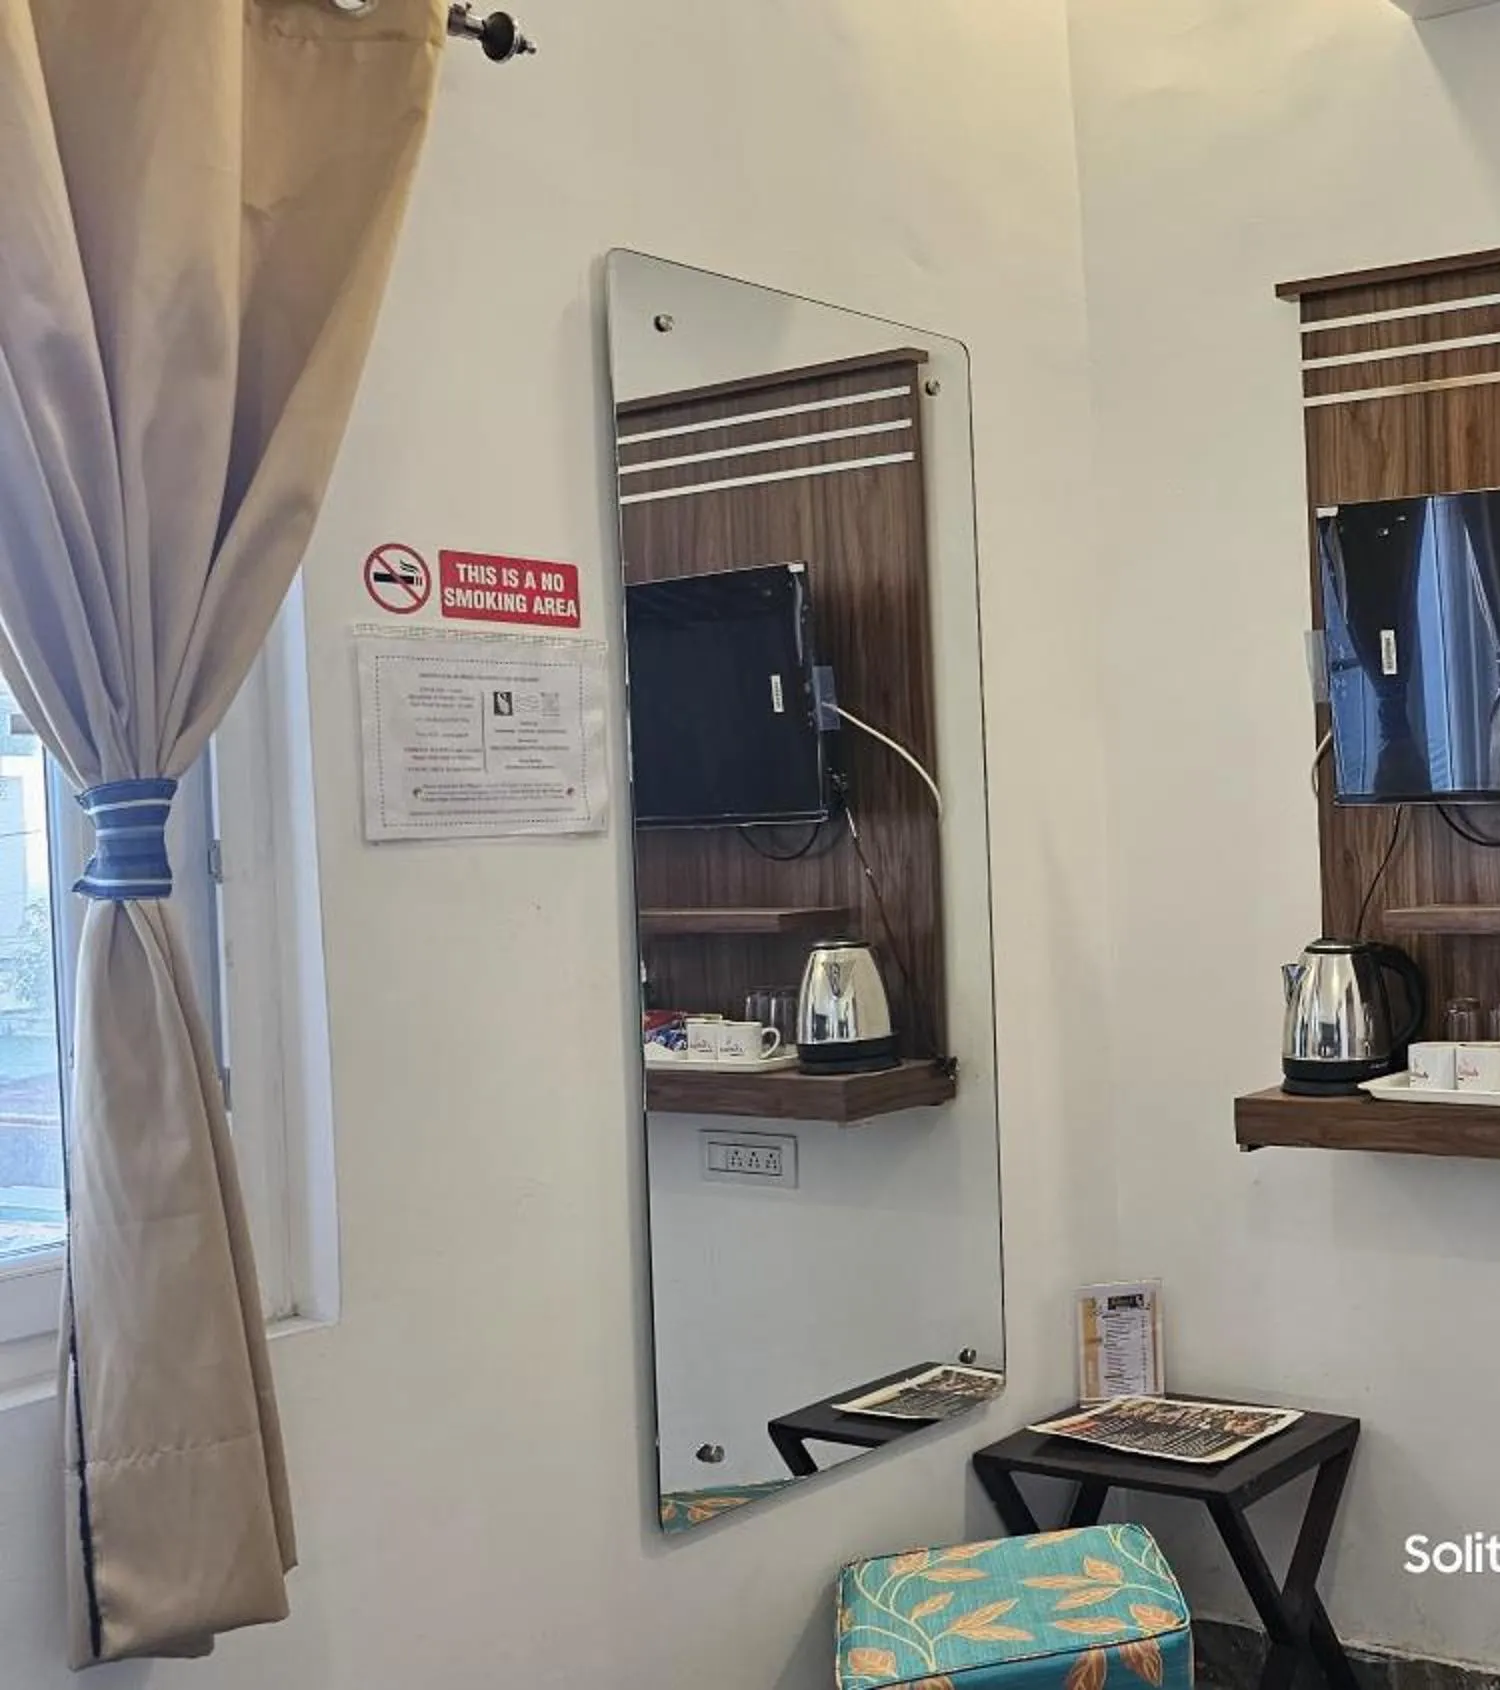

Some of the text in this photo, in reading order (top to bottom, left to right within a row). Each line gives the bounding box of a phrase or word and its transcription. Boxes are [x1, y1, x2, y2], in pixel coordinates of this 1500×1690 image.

[456, 563, 565, 593] THIS IS A NO
[444, 587, 578, 618] SMOKING AREA
